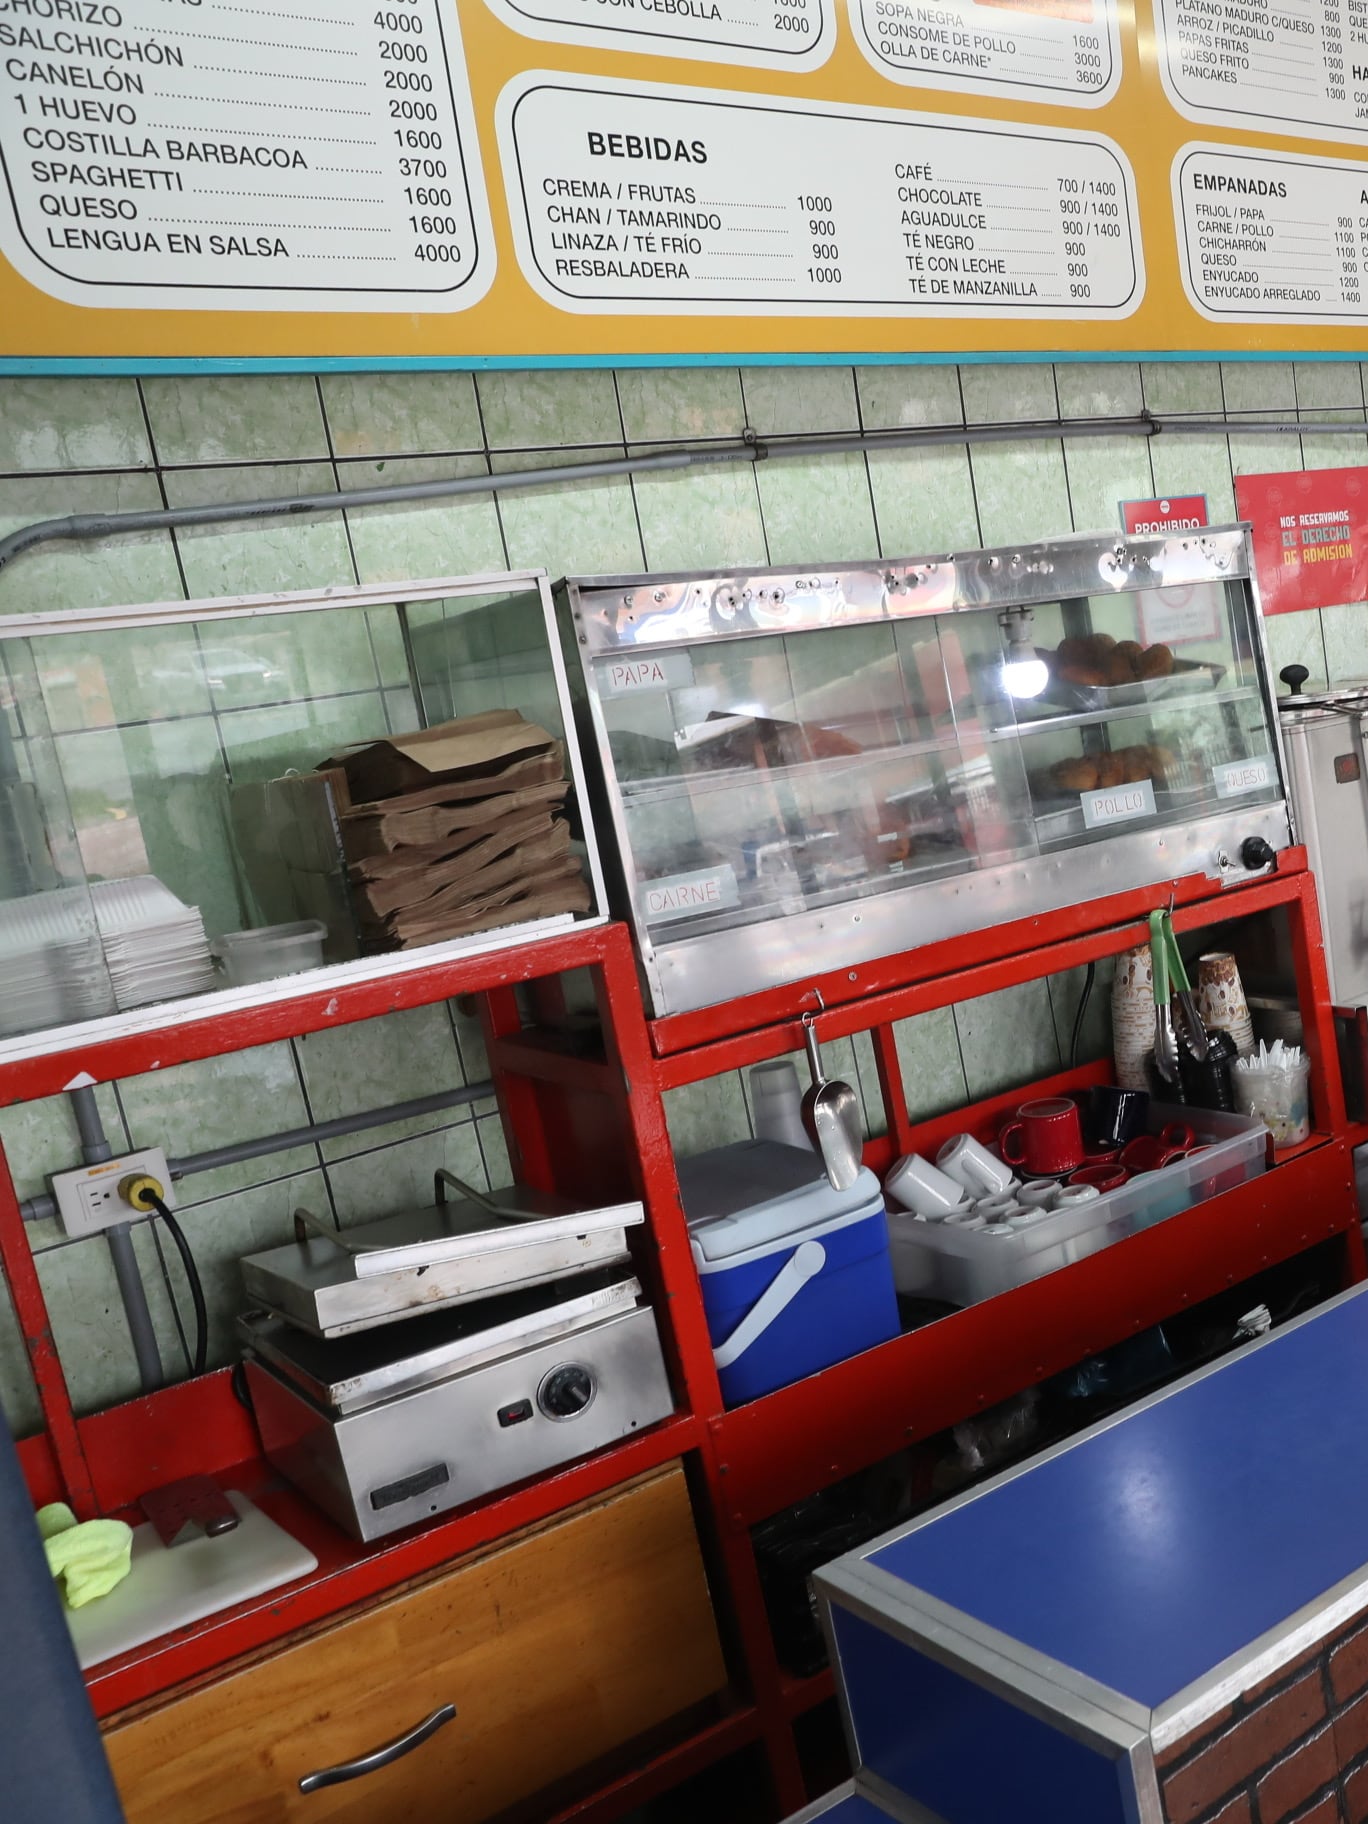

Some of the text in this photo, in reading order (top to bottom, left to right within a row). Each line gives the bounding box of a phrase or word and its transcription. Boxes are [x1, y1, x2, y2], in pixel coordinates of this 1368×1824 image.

[374, 11, 423, 34] 4000
[774, 13, 809, 34] 2000
[875, 1, 1099, 50] SOPA NEGRA 1600
[1177, 13, 1274, 42] ARROZ PICADILLO
[1225, 6, 1269, 26] MADURO
[1271, 15, 1315, 35] C/QUESO
[1321, 25, 1341, 39] 1300
[1324, 10, 1340, 24] 800
[0, 0, 428, 63] HORIZO 2000
[878, 21, 1101, 68] CONSOME DE POLLO 3000
[1178, 30, 1249, 54] PAPAS FRITAS
[1350, 30, 1356, 42] 2
[0, 23, 432, 92] SALCHICHÓN 2000
[880, 40, 917, 58] OLLA
[920, 46, 939, 61] DE
[1076, 70, 1103, 85] 3600
[1180, 48, 1345, 85] QUESO FRITO 900
[6, 58, 144, 94] CANELÓN
[1182, 64, 1346, 101] PANCAKES 1300
[14, 94, 442, 150] 1 HUEVO 1600
[23, 127, 447, 178] COSTILLA BARBACOA 3700
[587, 132, 707, 164] BEBIDAS
[31, 160, 451, 207] SPAGHETTI 1600
[895, 162, 1116, 196] CAFÉ 700 1400
[1193, 173, 1287, 198] EMPANADAS
[40, 194, 137, 220] QUESO
[543, 178, 832, 212] CREMA FRUTAS 1000
[898, 187, 1118, 217] CHOCOLATE 900 1400
[547, 205, 835, 236] CHAN TAMARINDO 900
[901, 210, 1121, 238] AGUADULCE 900 1400
[1195, 203, 1353, 229] FRIJOL PAPA 900
[47, 227, 461, 263] LENGUA EN SALSA 4000
[551, 232, 702, 254] LINAZA TÉ FRÍO
[902, 229, 1086, 256] TÉ NEGRO 900
[1197, 220, 1354, 244] CARNE POLLO 1100
[1199, 236, 1266, 252] CHICHARRÓN
[555, 259, 842, 283] RESBALADERA 1000
[905, 252, 1006, 274] TÉ CON LECHE
[1201, 253, 1237, 266] QUESO
[908, 275, 1091, 298] TÉ DE MANZANILLA 900
[1202, 269, 1359, 288] ENYUCADO 1200
[1204, 285, 1361, 303] ENYUCADO ARREGLADO 1400
[1134, 517, 1200, 534] PROHIBIDO
[1280, 510, 1349, 528] NOS RESERVAMOS
[1282, 525, 1350, 547] EL DERECHO
[1284, 543, 1353, 566] DE ADMISION
[612, 662, 664, 686] PAPA
[1226, 767, 1266, 787] QUESO
[649, 881, 720, 912] CARNE
